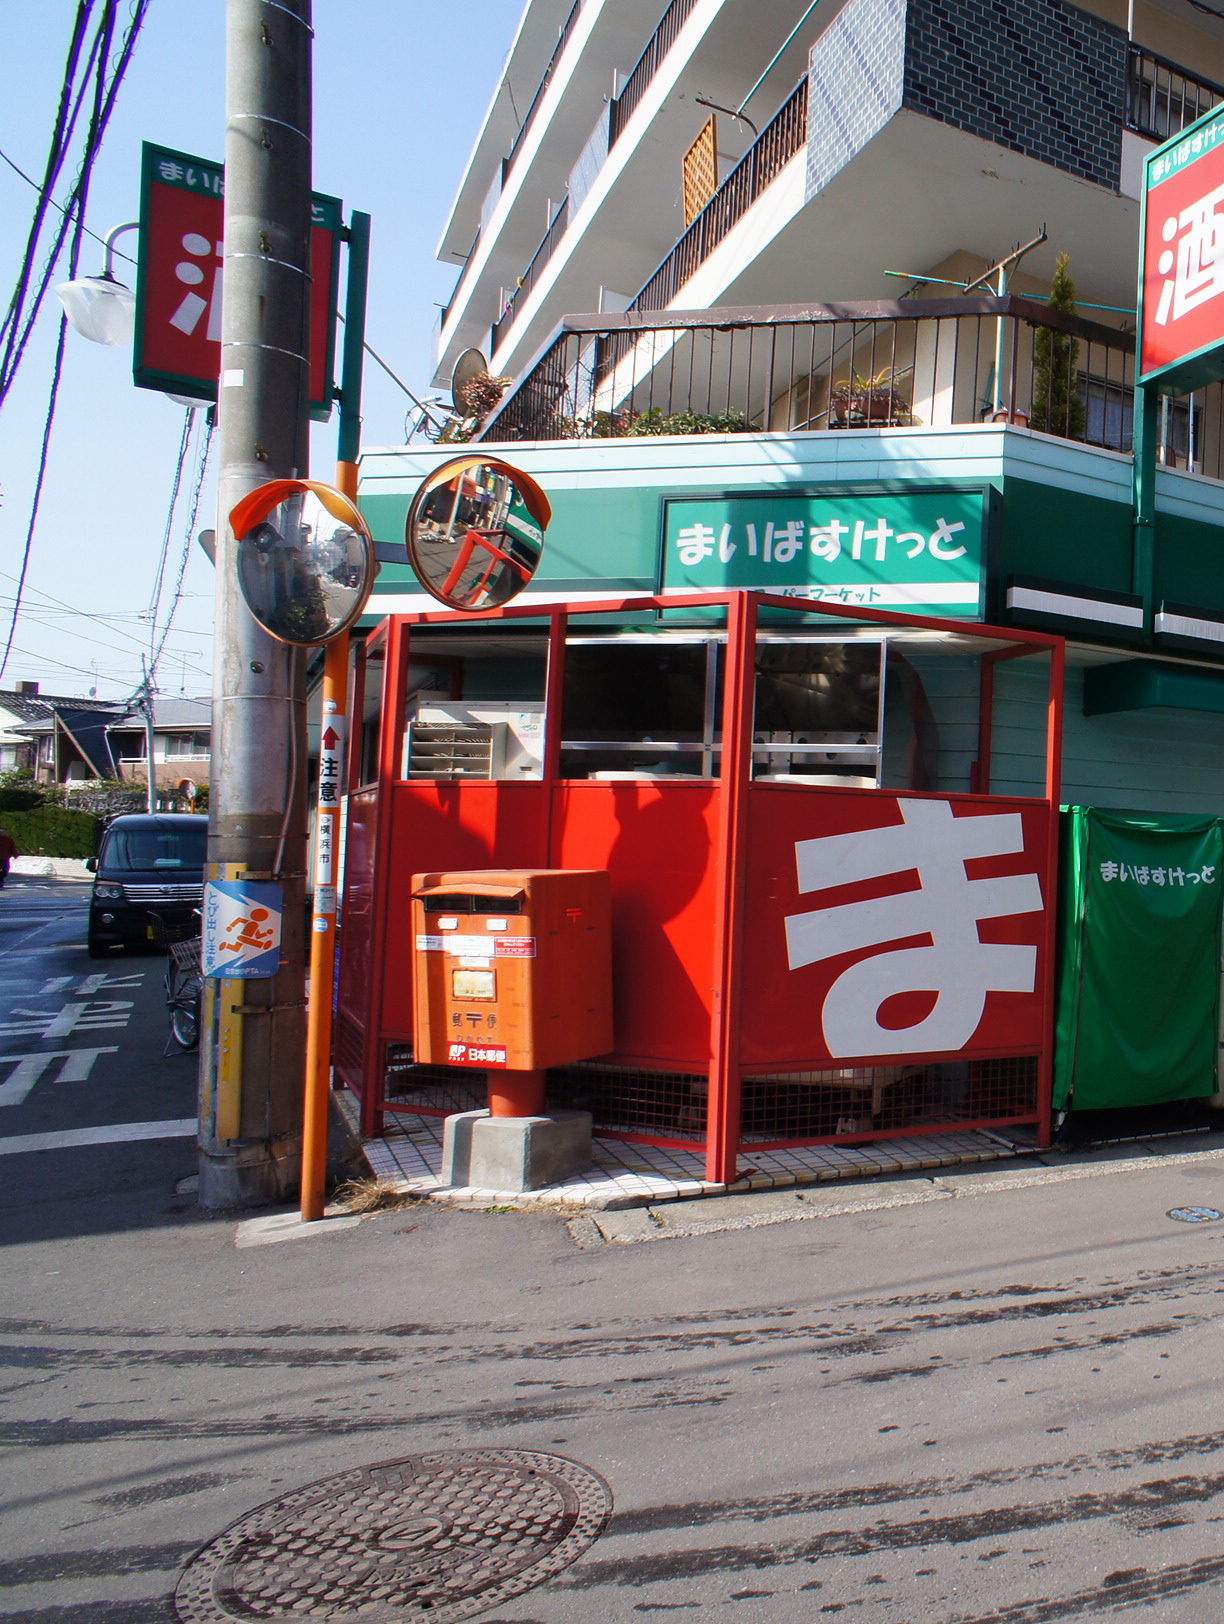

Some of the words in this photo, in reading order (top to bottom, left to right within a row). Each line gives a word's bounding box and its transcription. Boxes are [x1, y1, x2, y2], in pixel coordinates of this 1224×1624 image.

[676, 517, 968, 566] まいばすけっと
[319, 757, 339, 802] 注意
[319, 824, 331, 865] 横浜市
[1100, 860, 1216, 887] まいばすけっと
[784, 797, 1044, 1059] ま
[468, 1048, 507, 1062] 日本郵便
